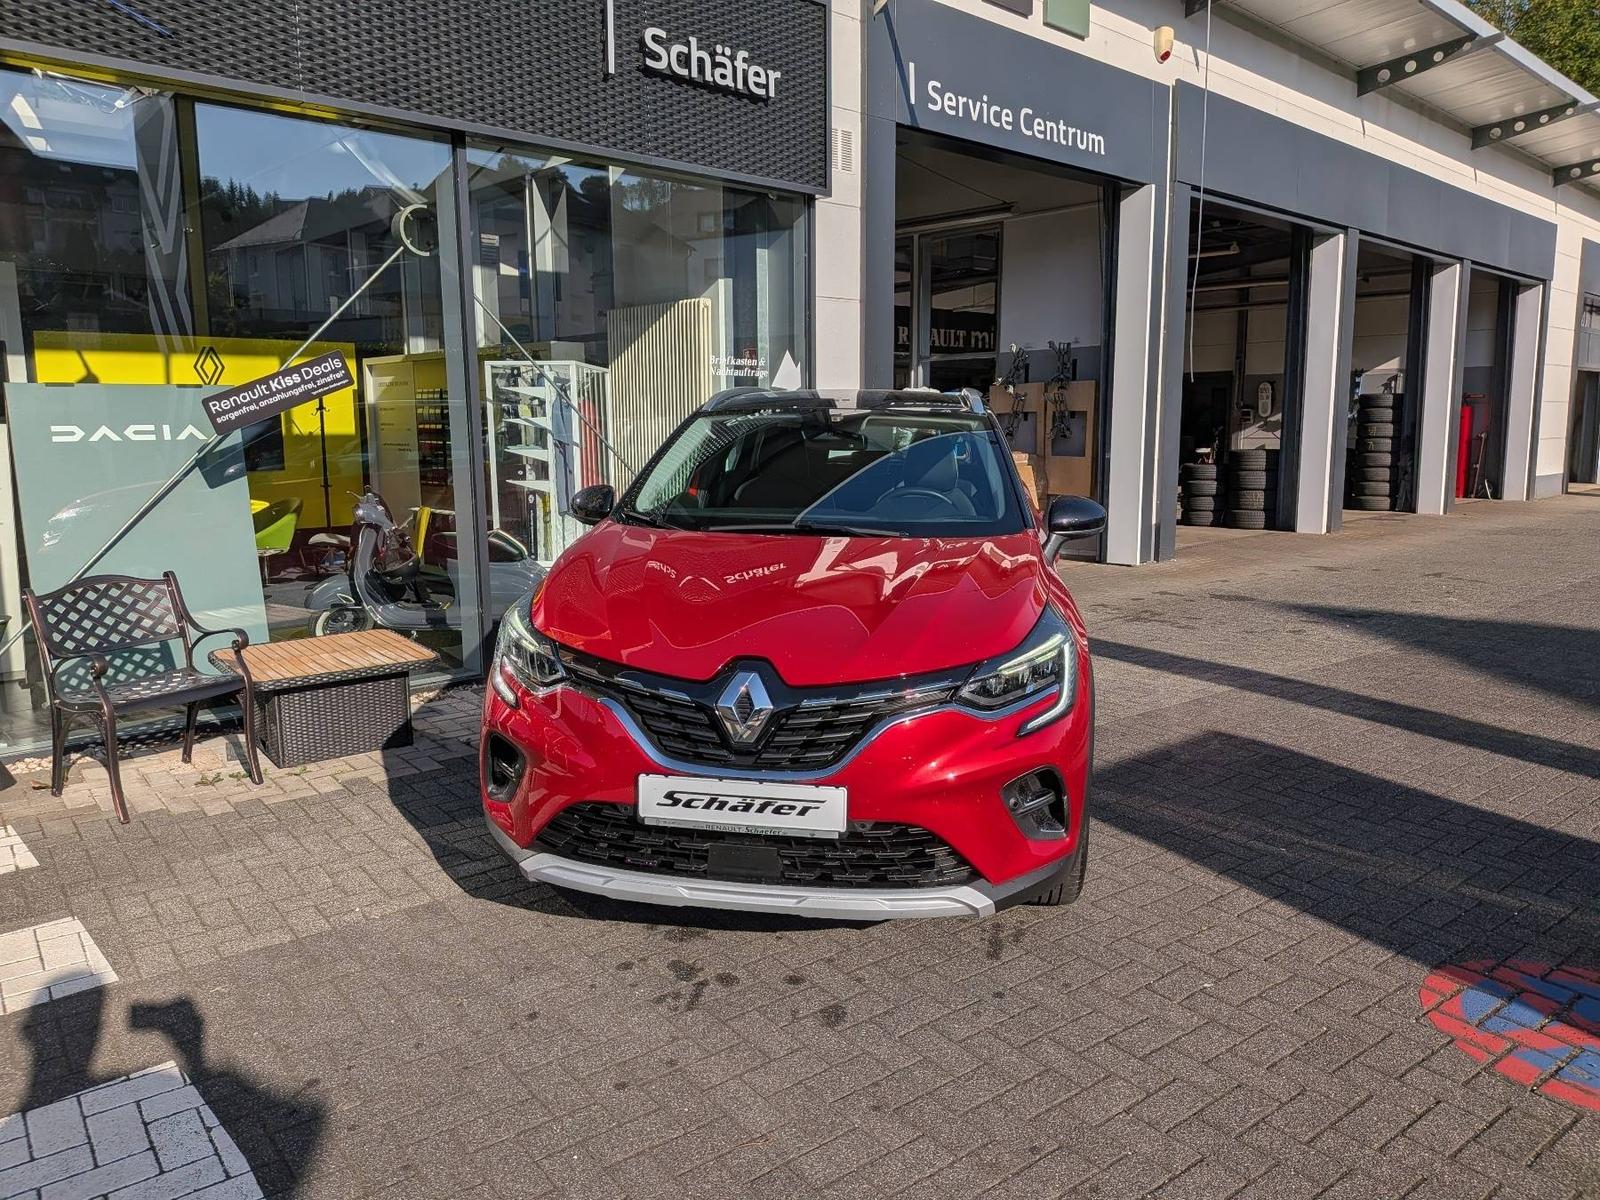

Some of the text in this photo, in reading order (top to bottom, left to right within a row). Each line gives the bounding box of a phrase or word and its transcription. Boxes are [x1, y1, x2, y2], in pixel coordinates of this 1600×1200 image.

[643, 27, 782, 98] Schäfer
[927, 80, 1106, 156] Service Centrum
[710, 355, 766, 366] Briefkasten &
[208, 383, 270, 415] Renault
[268, 373, 301, 393] Kiss
[300, 357, 343, 381] Deals
[216, 402, 260, 425] sorgenfrei,
[259, 381, 318, 408] anzahlungsfrei,
[50, 424, 209, 443] DACIA
[655, 789, 827, 818] Schäfer
